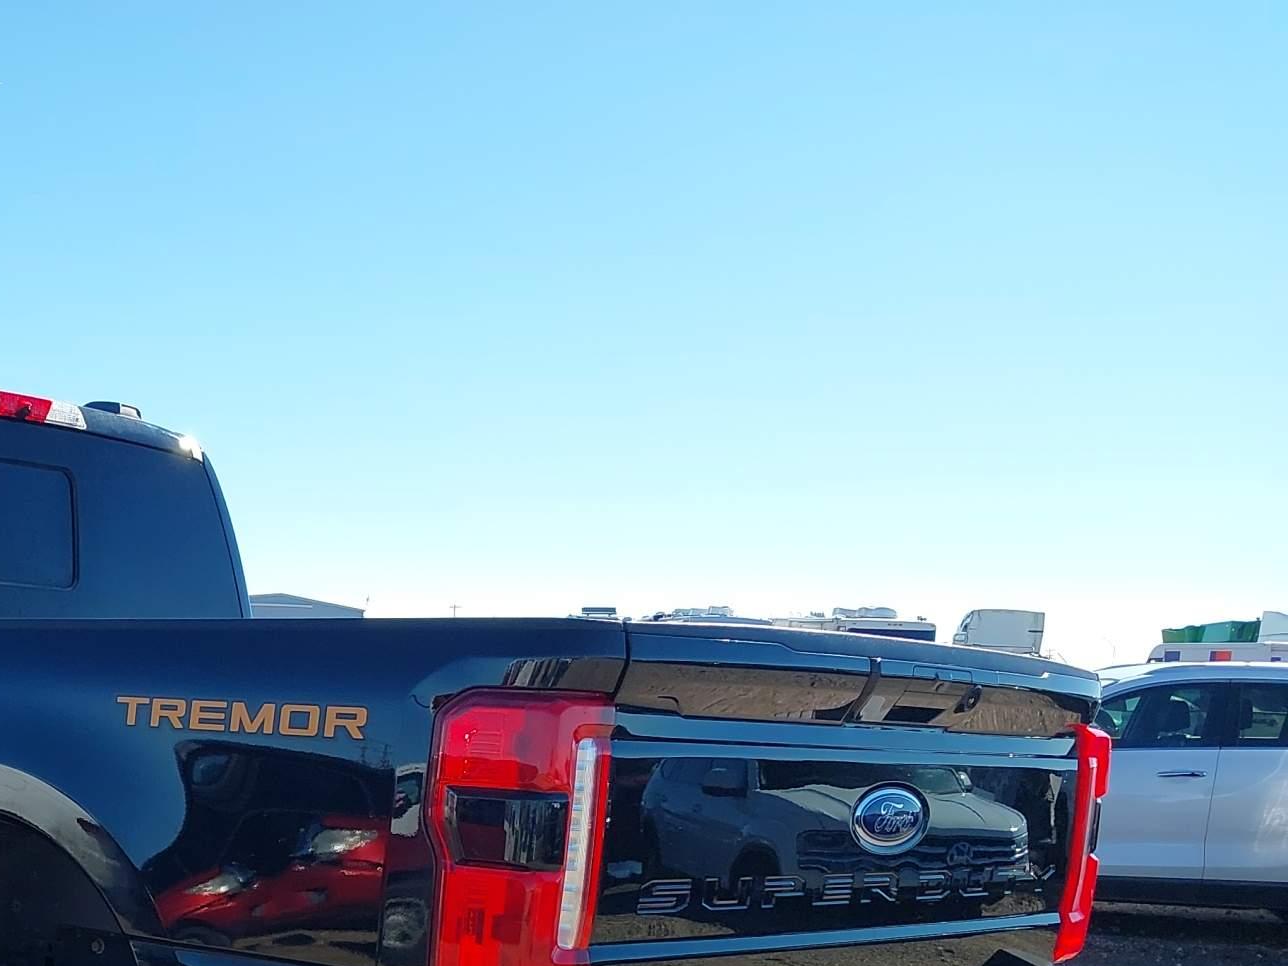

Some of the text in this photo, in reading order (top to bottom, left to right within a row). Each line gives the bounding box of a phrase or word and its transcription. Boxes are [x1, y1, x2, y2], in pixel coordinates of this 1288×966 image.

[116, 695, 369, 741] TREMOR
[873, 800, 915, 833] Ford
[636, 872, 900, 915] SUPER
